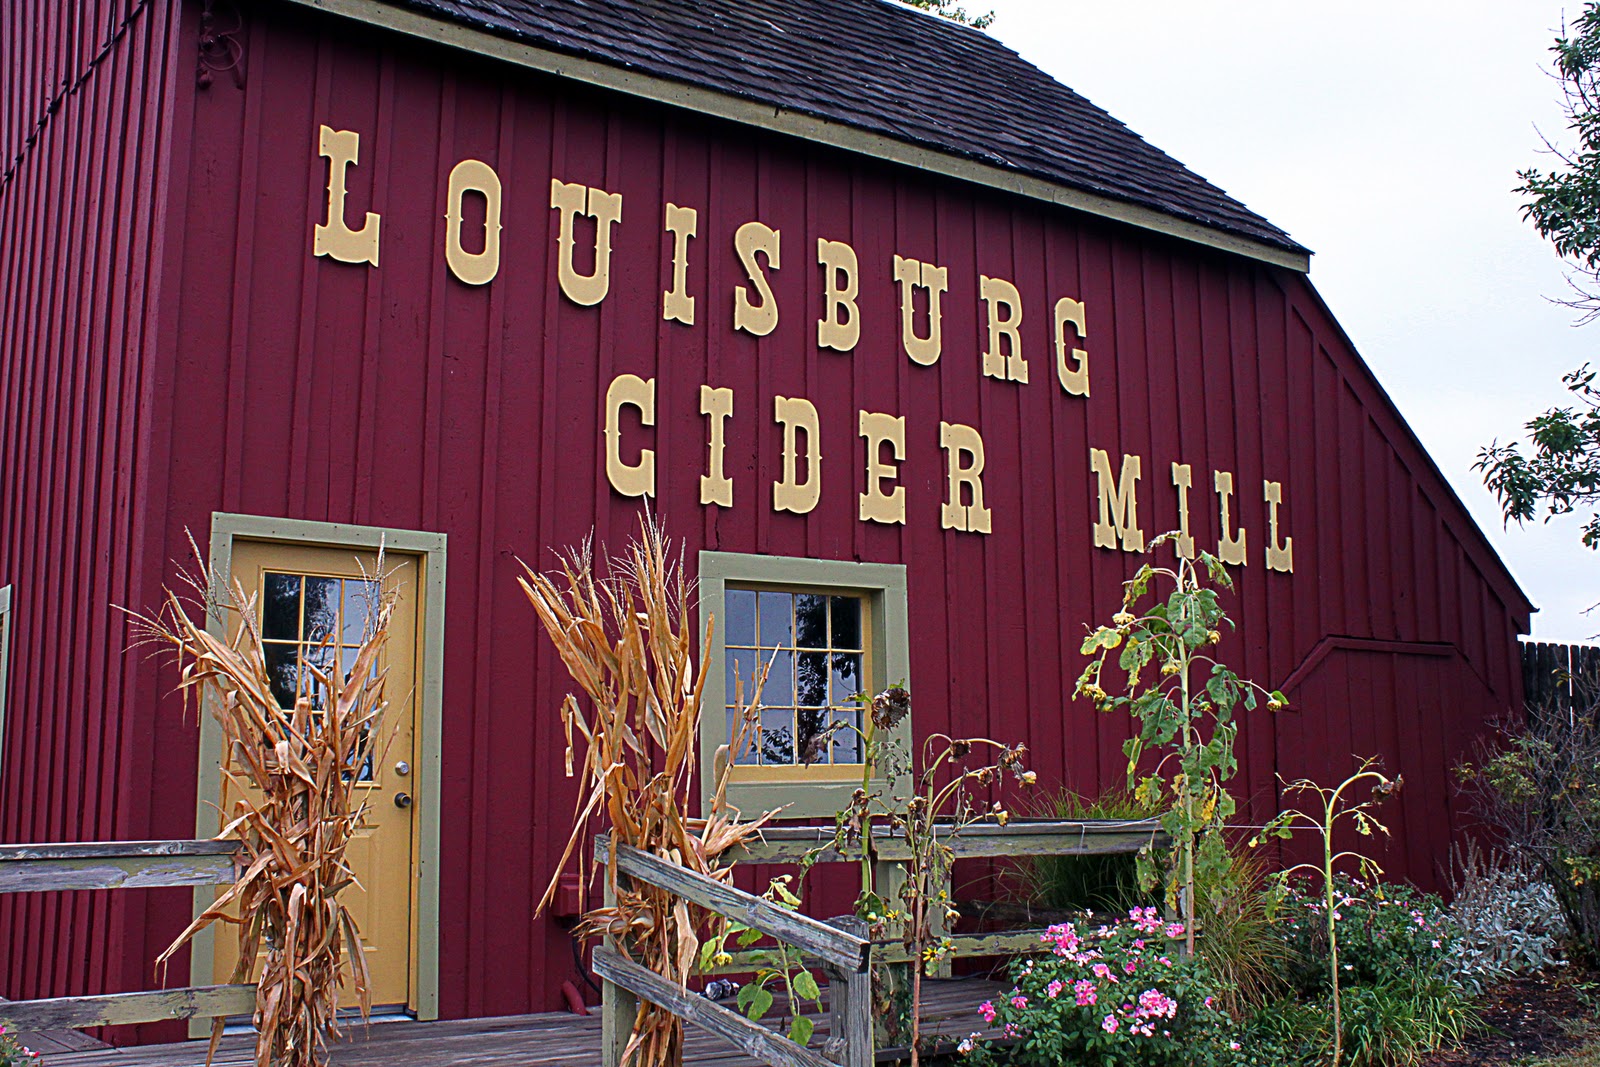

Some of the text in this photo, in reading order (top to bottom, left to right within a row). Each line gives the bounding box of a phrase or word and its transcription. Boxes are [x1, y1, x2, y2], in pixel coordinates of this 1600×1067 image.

[313, 124, 1091, 398] LOUISBURG
[605, 373, 1294, 574] CIDER MILL
